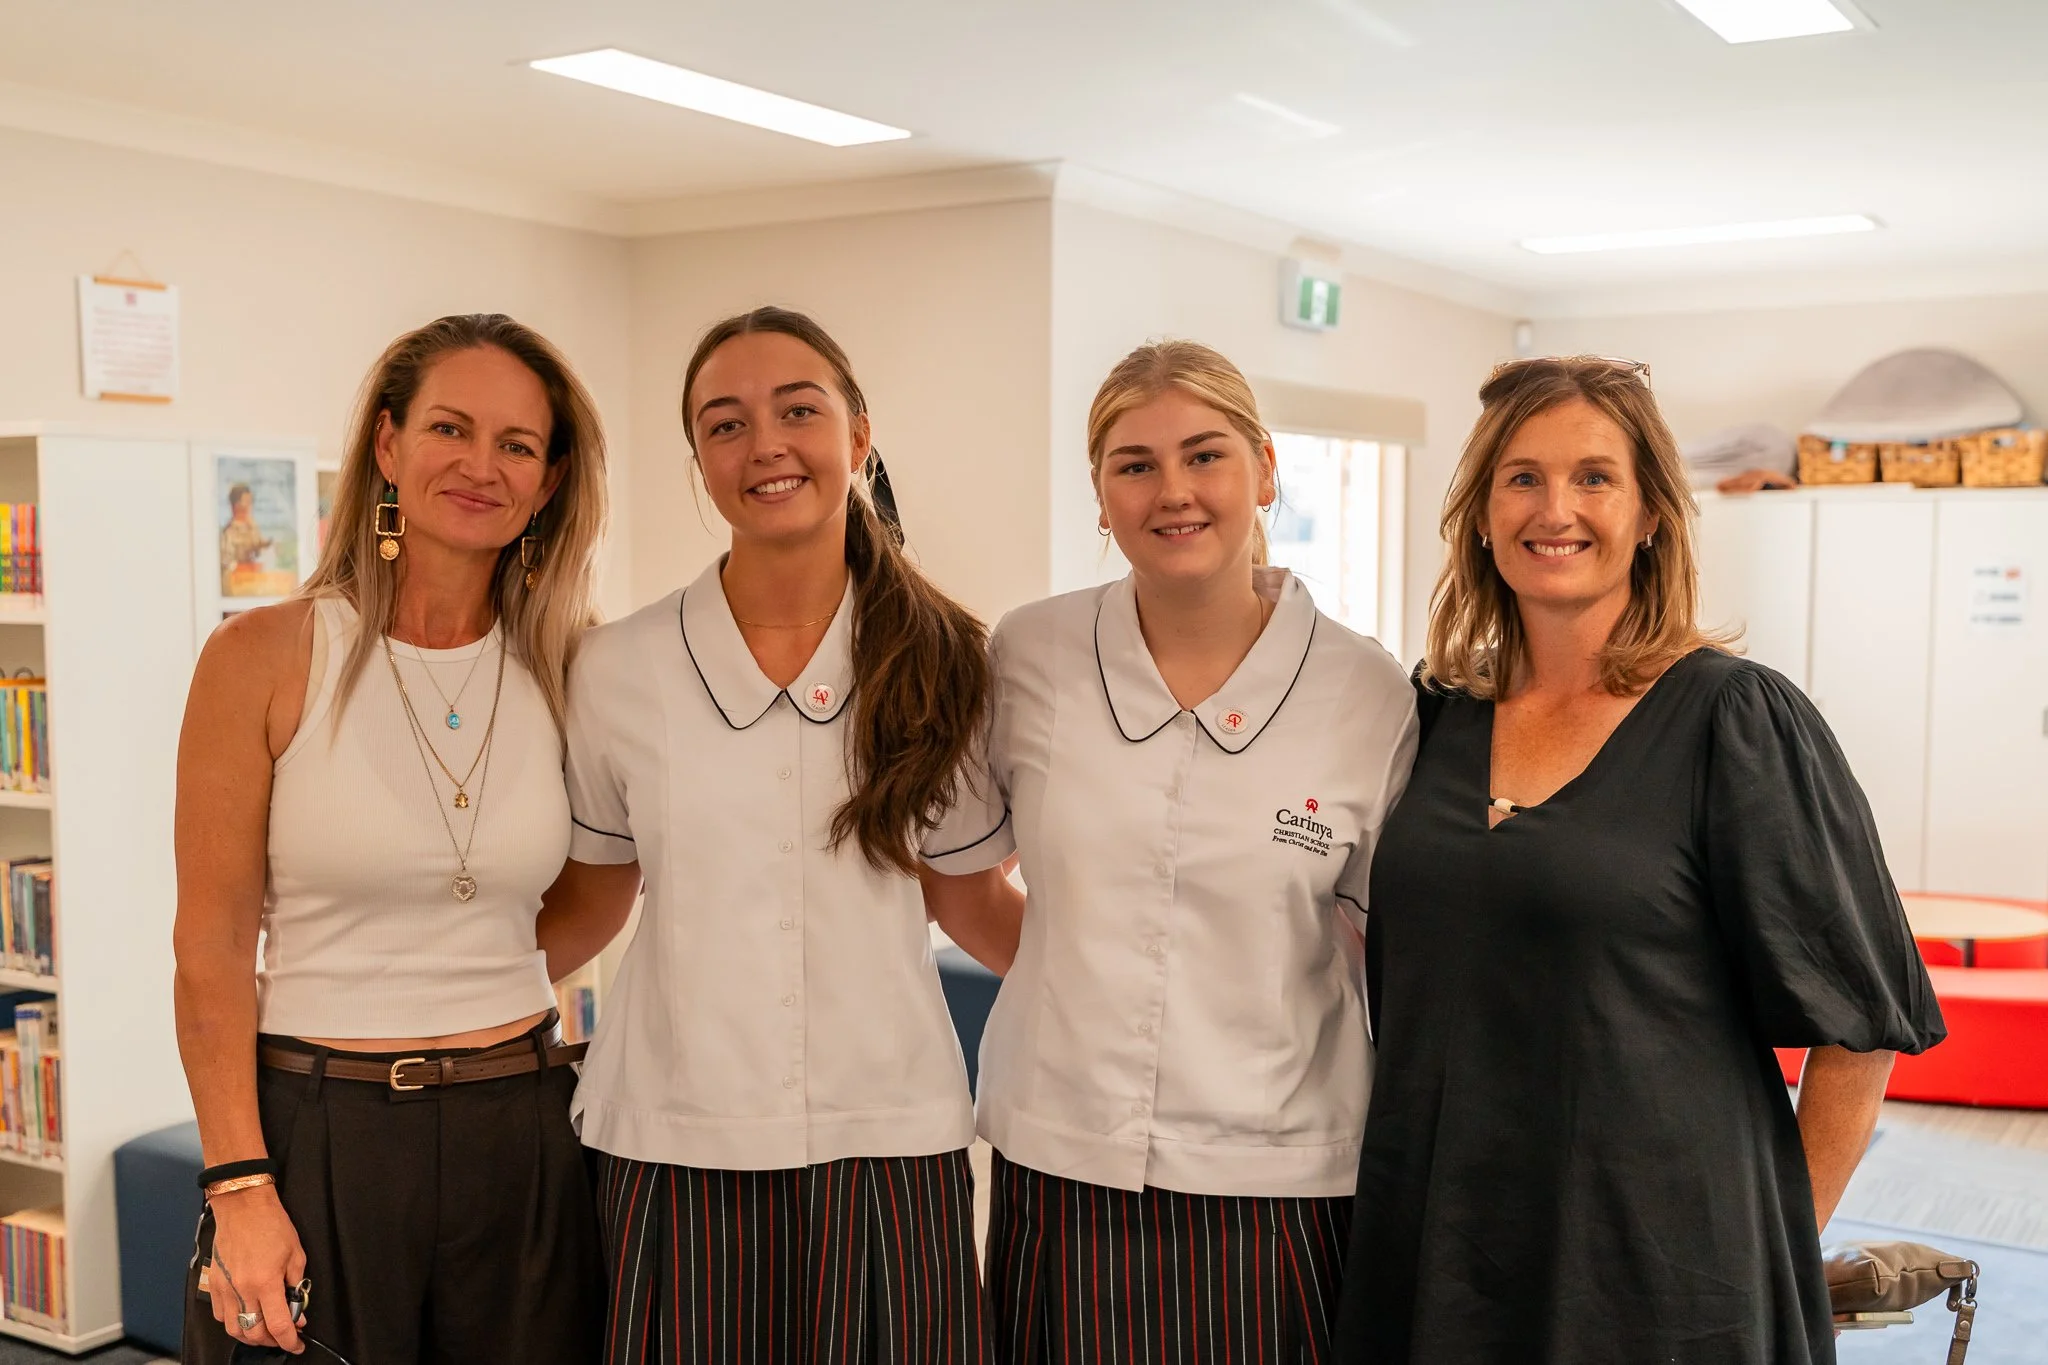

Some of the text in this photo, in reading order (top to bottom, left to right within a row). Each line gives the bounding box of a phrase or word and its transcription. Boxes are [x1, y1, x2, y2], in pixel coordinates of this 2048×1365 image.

[1276, 809, 1333, 840] Carinya
[1272, 835, 1287, 843] From
[1273, 828, 1330, 850] CHRISTIAN SCHOOL
